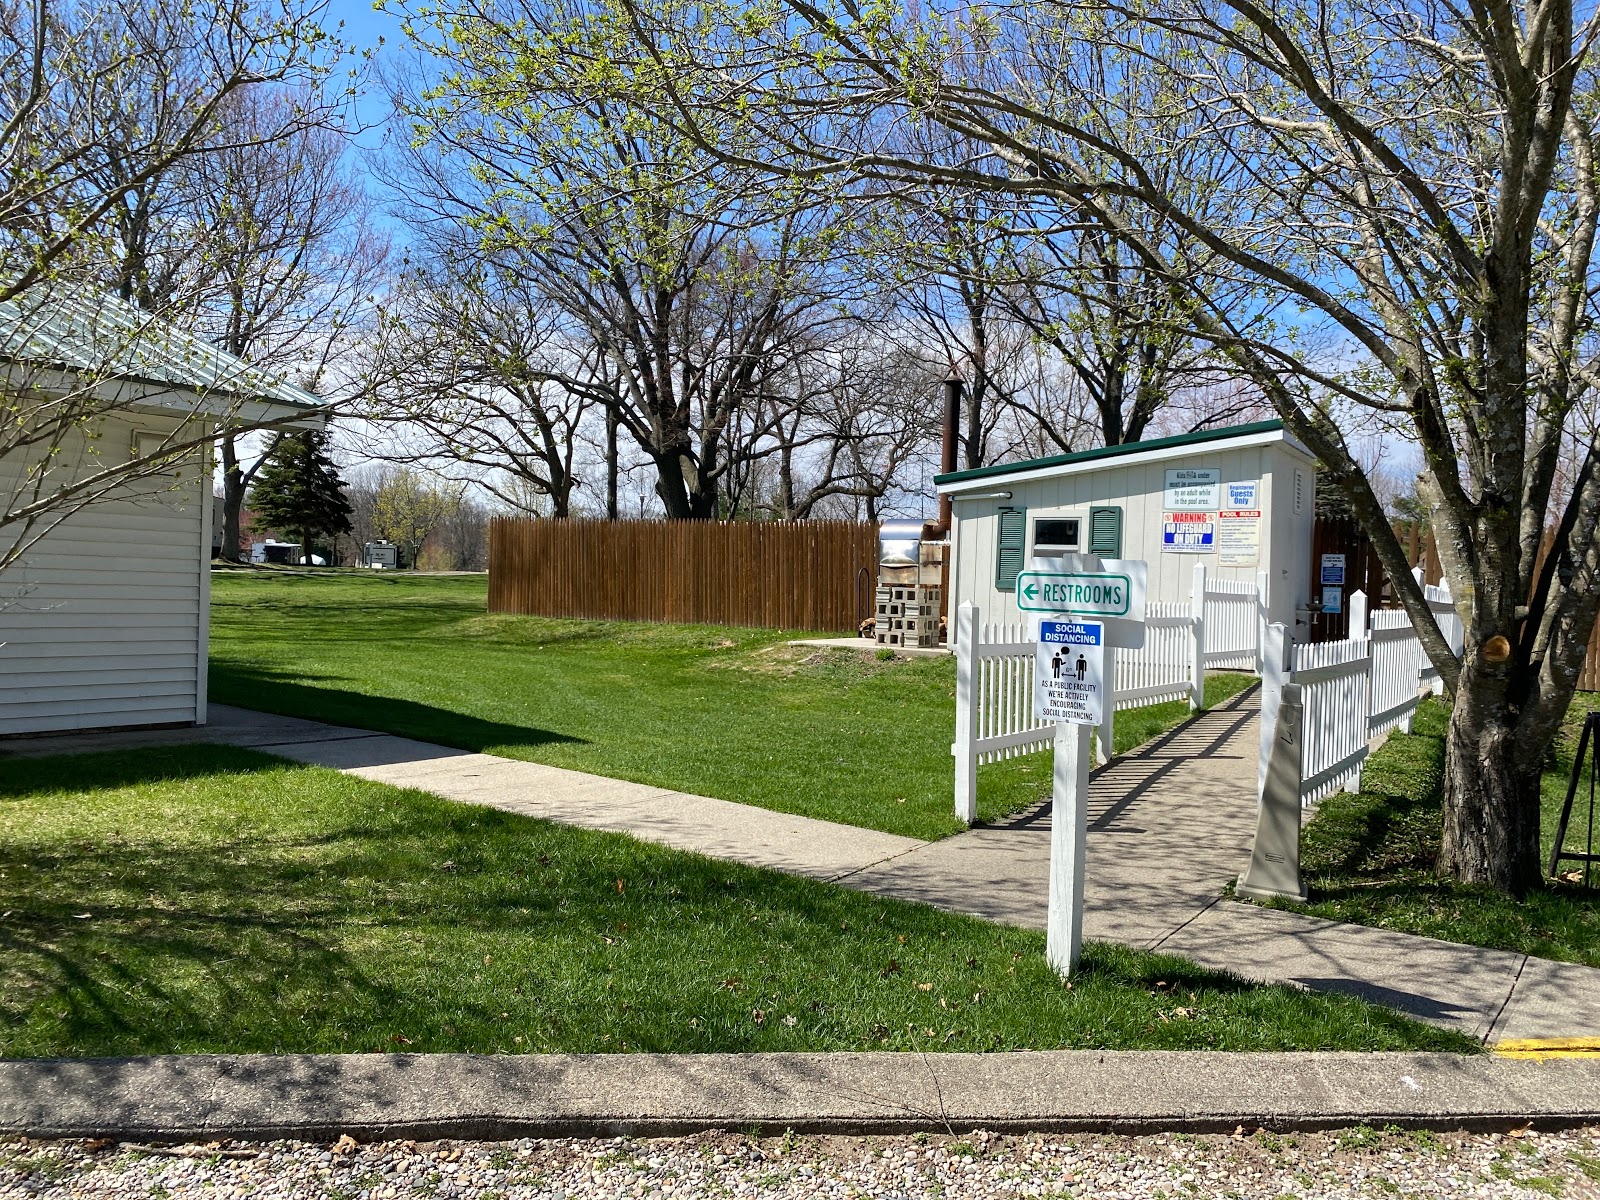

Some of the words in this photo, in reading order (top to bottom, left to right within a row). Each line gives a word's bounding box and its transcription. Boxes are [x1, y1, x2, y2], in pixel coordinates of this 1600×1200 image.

[1187, 480, 1215, 488] accompanied
[1173, 513, 1207, 522] WARNING
[1166, 524, 1176, 533] NO
[1177, 524, 1212, 534] LIFEGUARD
[1174, 534, 1184, 544] ON
[1185, 534, 1203, 544] DUTY
[1044, 584, 1121, 604] RESTROOMS
[1055, 624, 1086, 634] SOCIAL
[1045, 633, 1096, 644] DISTANCING
[1042, 680, 1048, 688] AS
[1054, 682, 1072, 690] PUBLIC
[1074, 683, 1096, 692] FACILITY
[1048, 690, 1063, 698] WE'RE
[1065, 692, 1089, 701] ACTIVELY
[1050, 700, 1086, 710] ENCOURAGING
[1042, 708, 1060, 716] SOCIAL
[1062, 710, 1092, 720] DISTANCING
